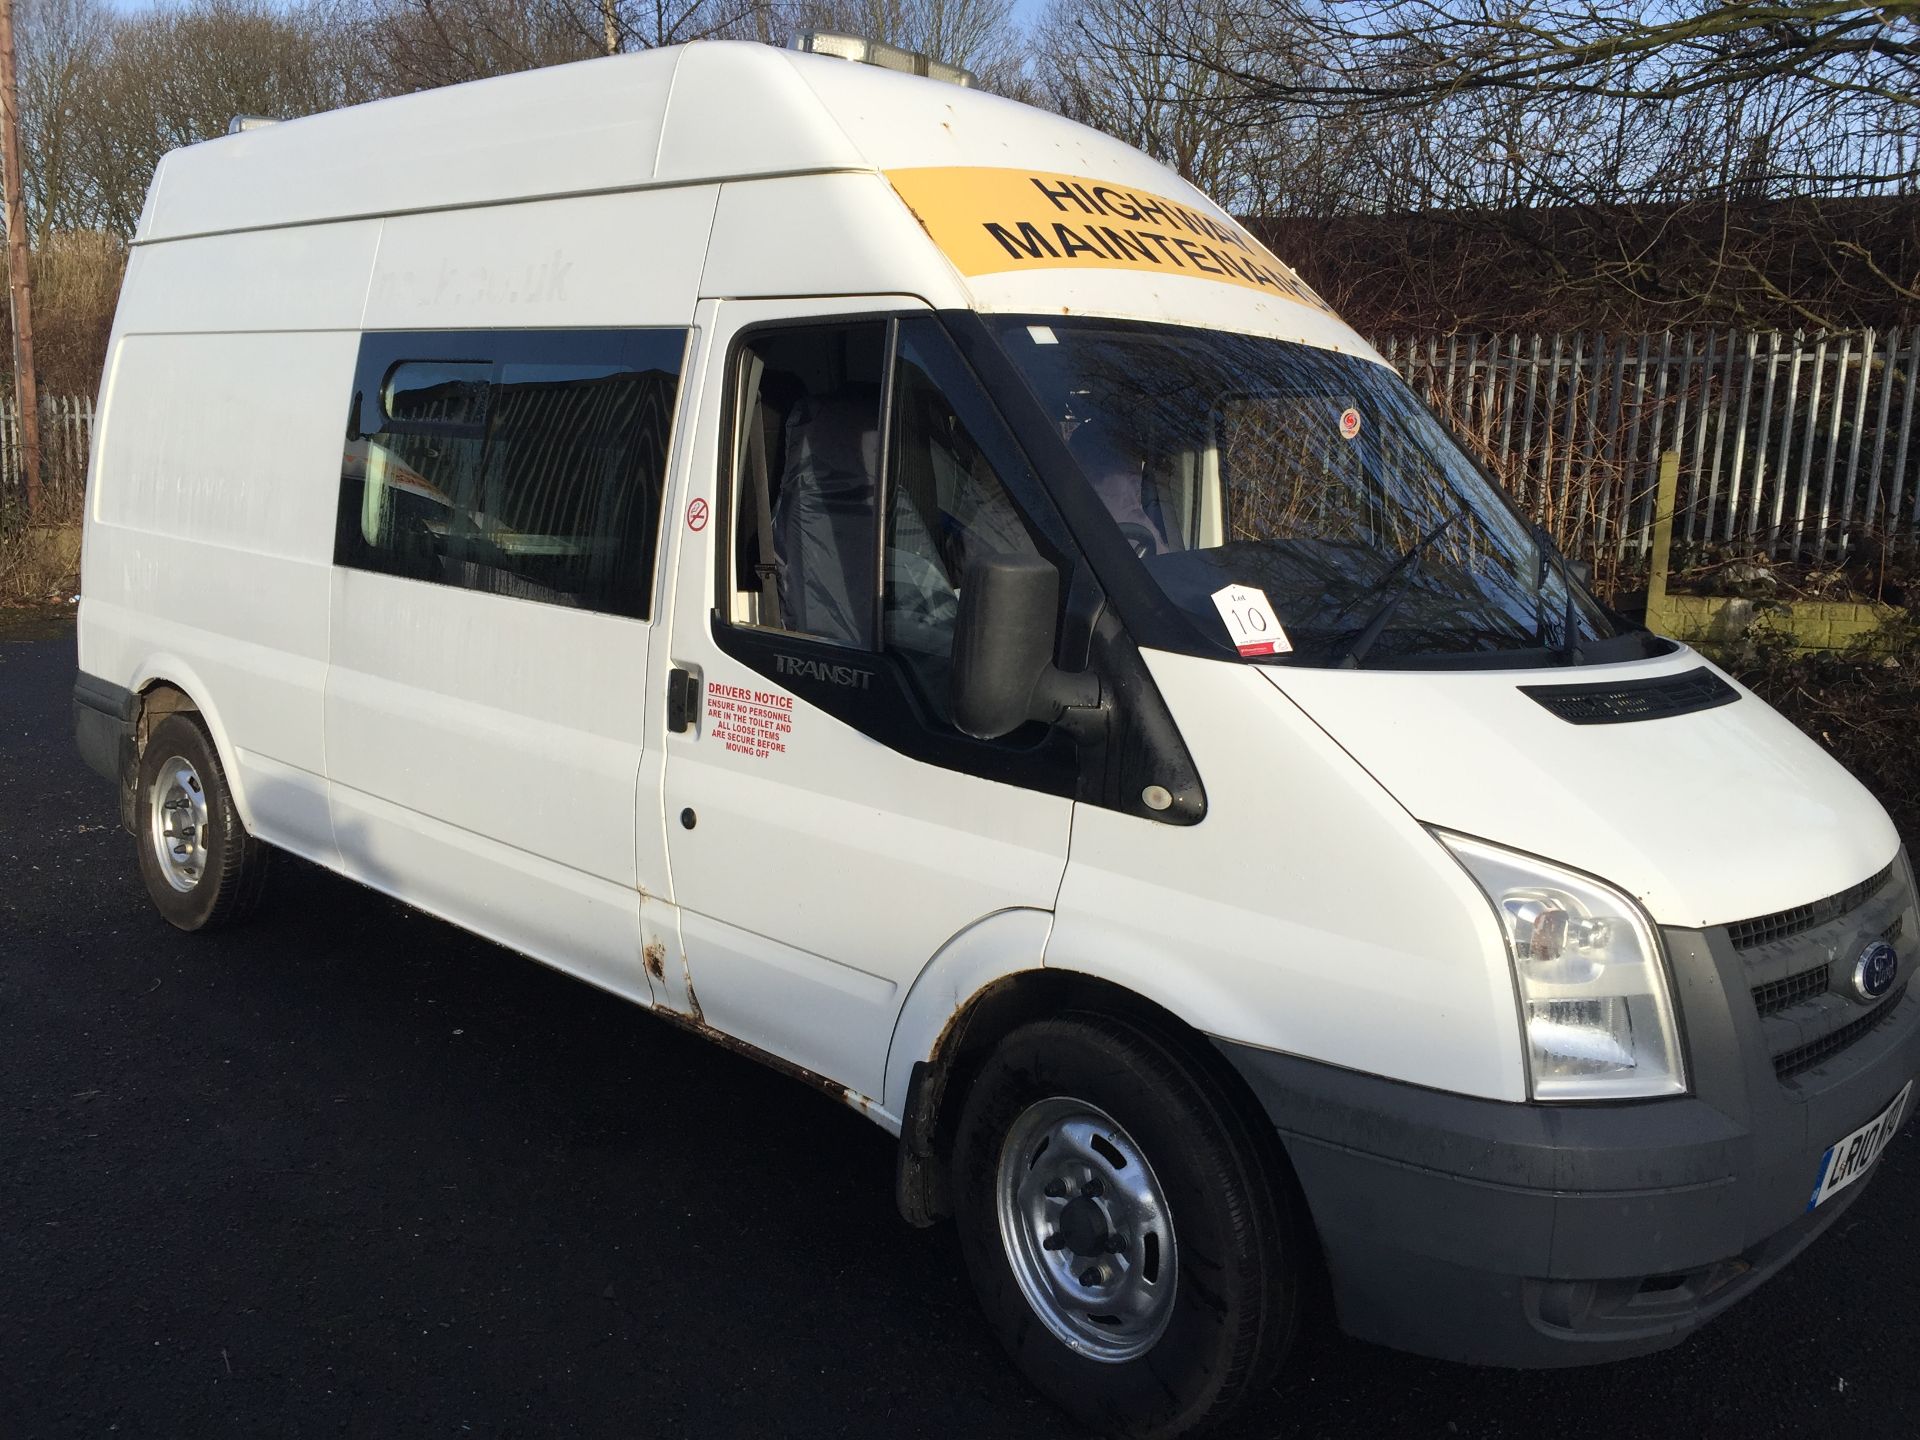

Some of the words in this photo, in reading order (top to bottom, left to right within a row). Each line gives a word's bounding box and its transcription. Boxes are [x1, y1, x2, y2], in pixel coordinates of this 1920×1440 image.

[1029, 177, 1256, 257] HIGHWAY
[983, 220, 1331, 313] MAINTENANC
[1231, 607, 1267, 634] 10
[773, 653, 874, 690] TRANSIT
[708, 682, 752, 700] DRIVERS
[754, 691, 793, 709] NOTICE
[708, 698, 735, 711] ENSURE
[737, 704, 747, 713] NO
[749, 706, 792, 723] PERSONNEL
[708, 708, 722, 719] ARE
[724, 711, 731, 720] IN
[733, 713, 747, 724] THE
[749, 716, 774, 729] TOILET
[776, 722, 792, 733] AND
[712, 729, 726, 739] ARE
[727, 732, 756, 746] SECURE
[757, 738, 786, 753] BEFORE
[718, 720, 731, 730] ALL
[732, 723, 756, 736] LOOSE
[757, 729, 780, 741] ITEMS
[726, 742, 754, 756] MOVING
[756, 748, 770, 759] OFF
